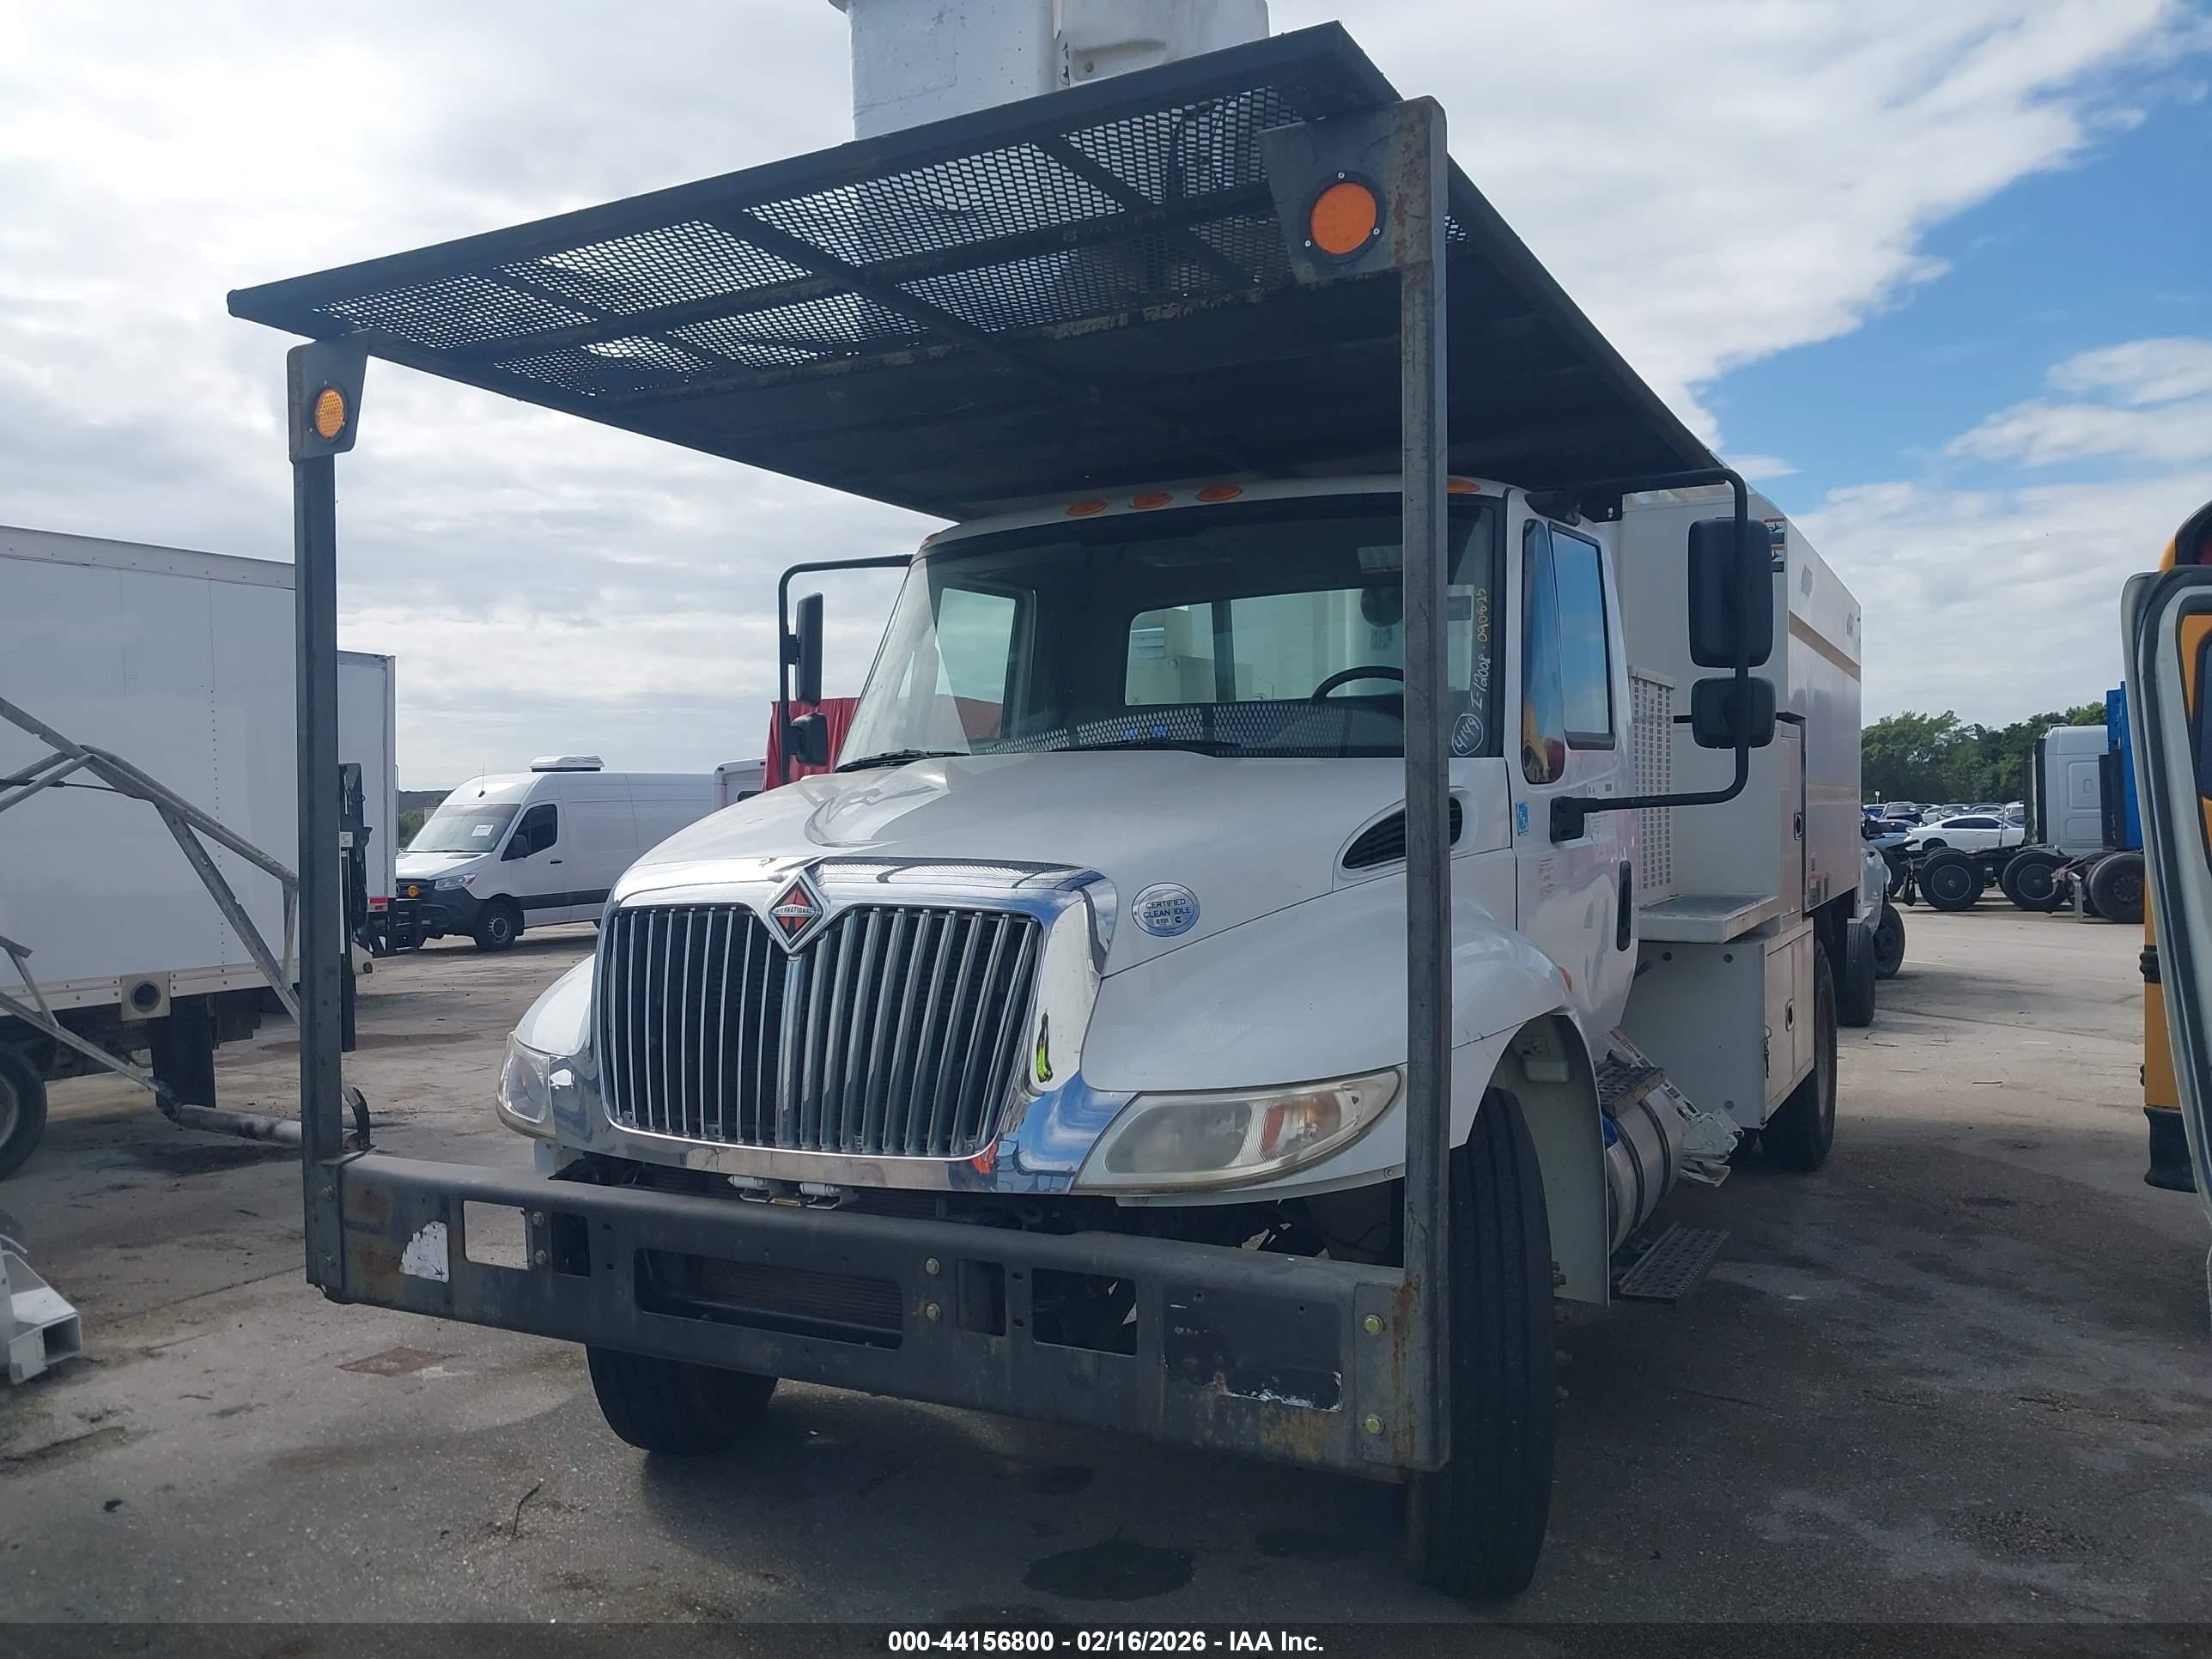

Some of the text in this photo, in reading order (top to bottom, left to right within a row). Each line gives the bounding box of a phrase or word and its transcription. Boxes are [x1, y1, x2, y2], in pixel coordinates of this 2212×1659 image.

[1455, 716, 1479, 750] 4149
[1146, 899, 1186, 908] CERTIFIED
[1144, 909, 1170, 918] CLEAN
